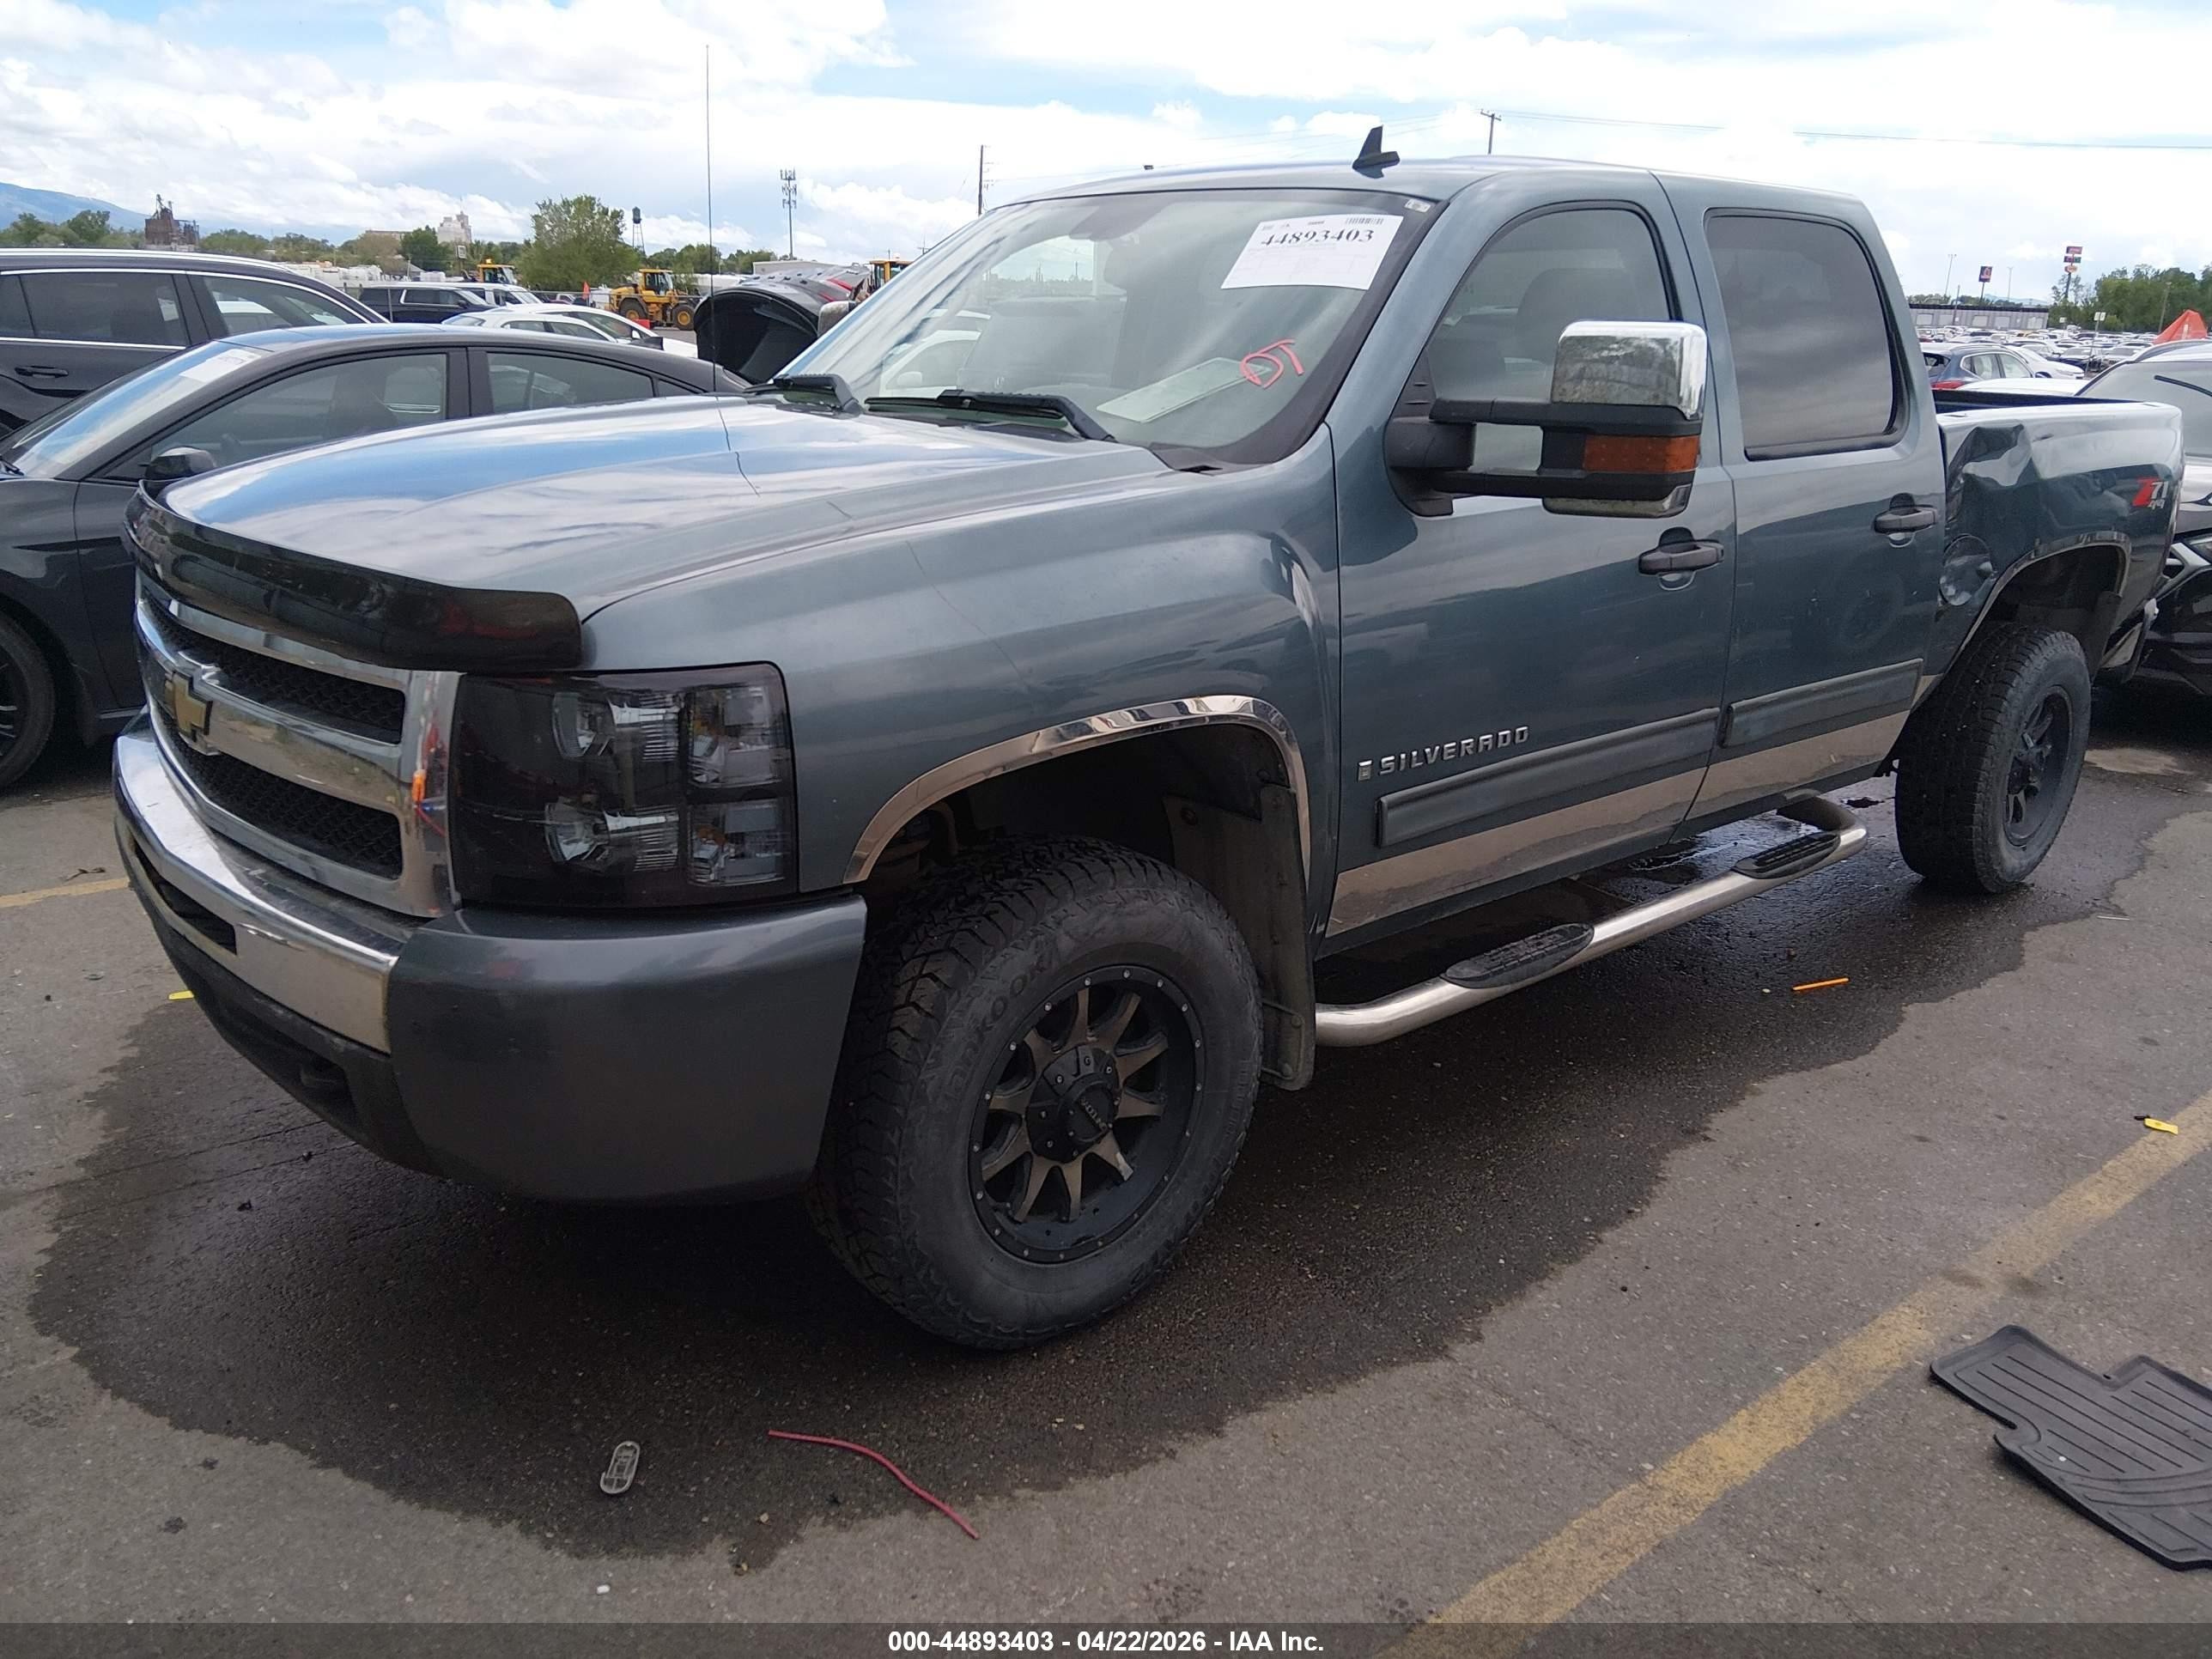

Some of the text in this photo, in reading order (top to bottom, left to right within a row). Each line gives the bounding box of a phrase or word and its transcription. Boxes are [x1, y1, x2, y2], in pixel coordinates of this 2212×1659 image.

[1261, 228, 1375, 246] 44893403
[2132, 477, 2169, 507] Z71
[1378, 726, 1529, 776] SILVERADO
